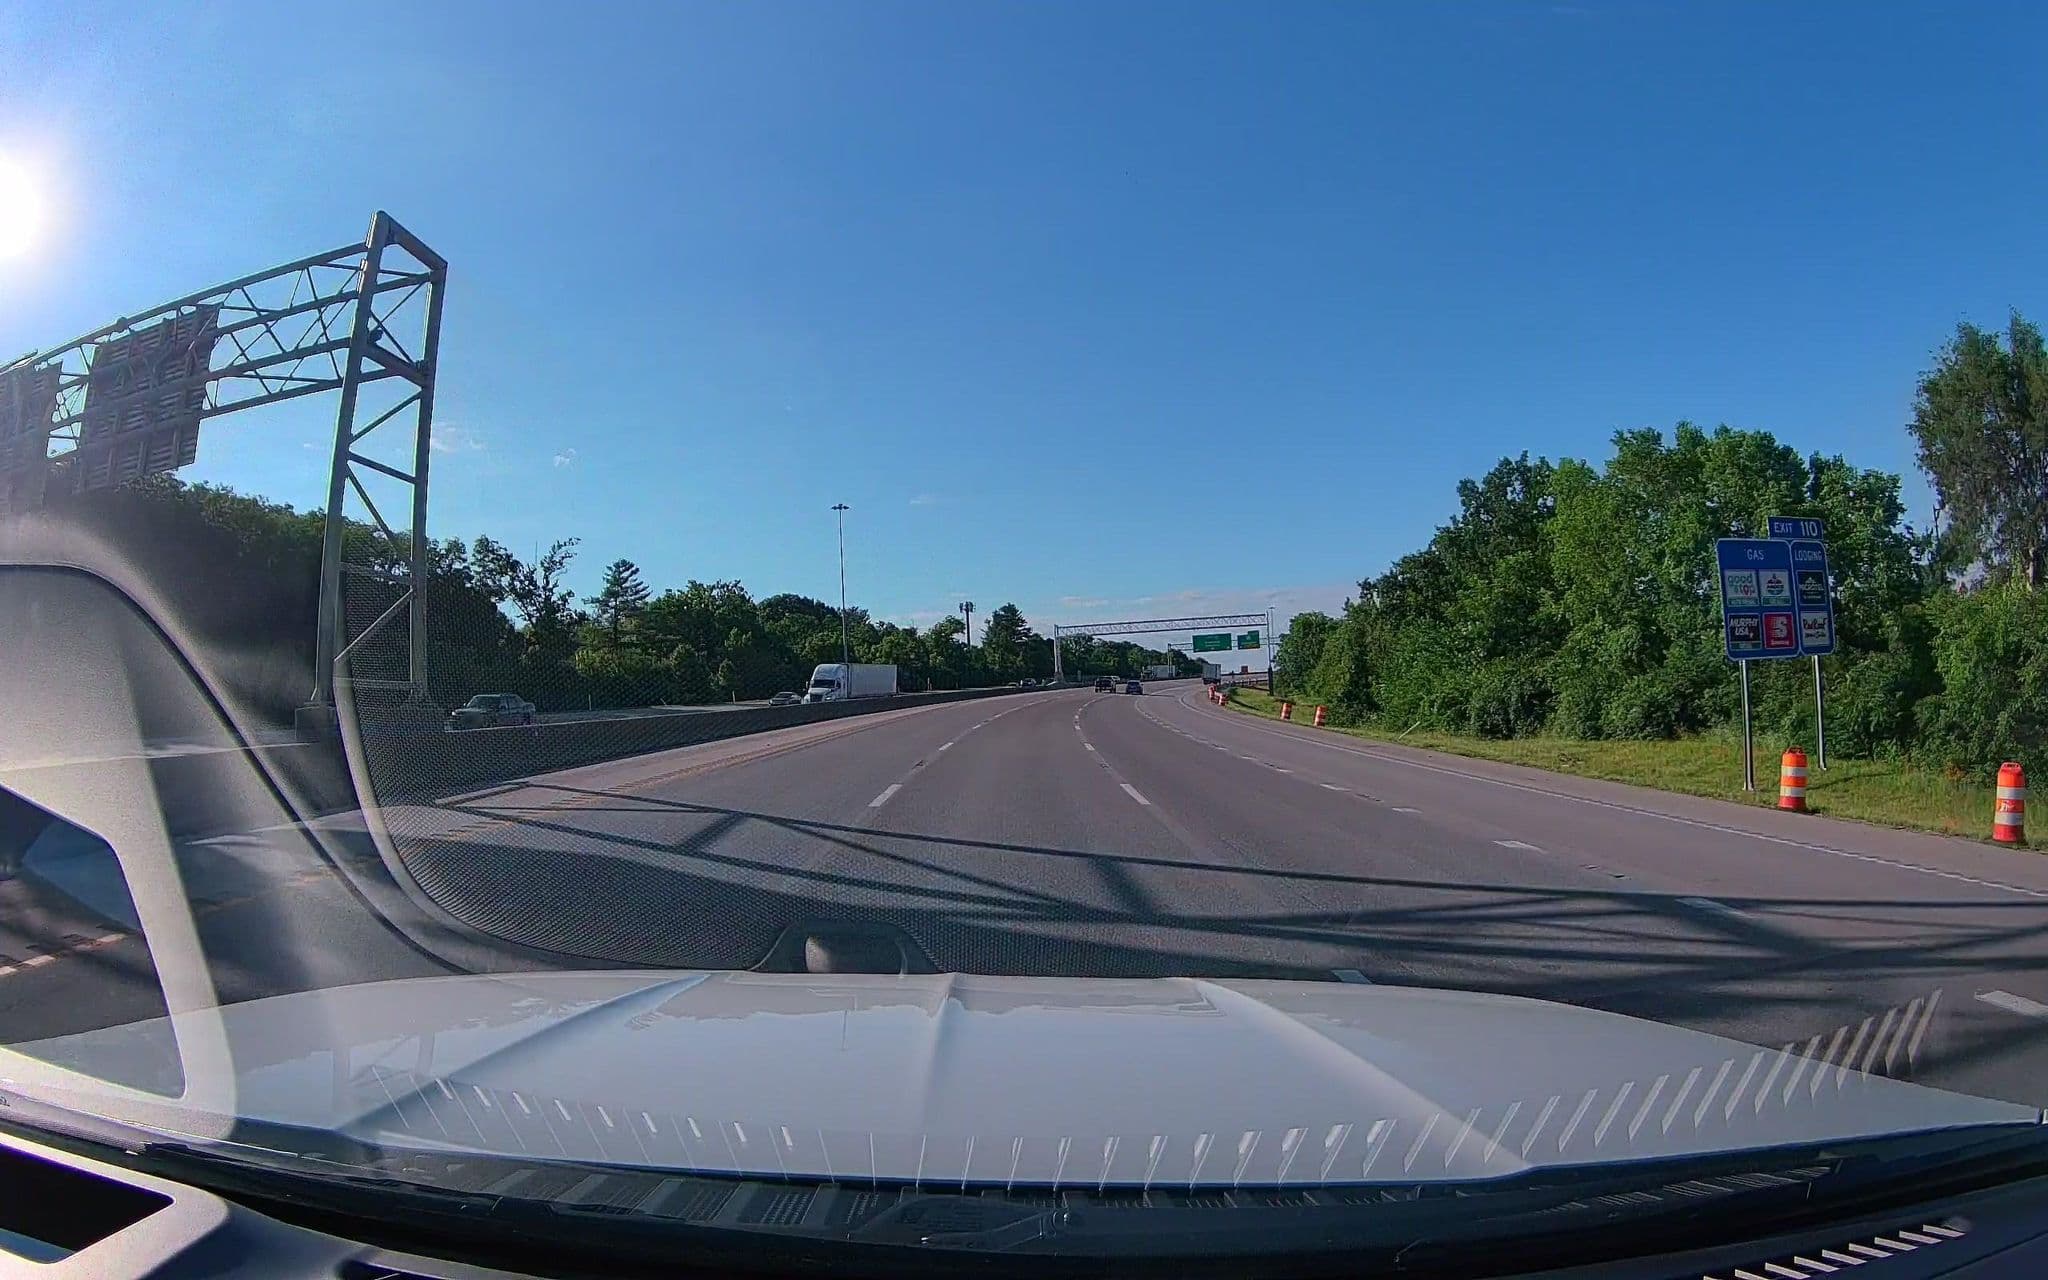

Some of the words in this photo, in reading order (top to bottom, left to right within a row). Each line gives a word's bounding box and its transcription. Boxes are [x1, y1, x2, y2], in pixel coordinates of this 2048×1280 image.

[1774, 522, 1792, 533] EXIT
[1800, 521, 1818, 536] 110
[1746, 548, 1764, 560] GAS
[1794, 550, 1822, 561] LODGING
[1729, 618, 1759, 627] MURPHY
[1735, 627, 1749, 636] USA
